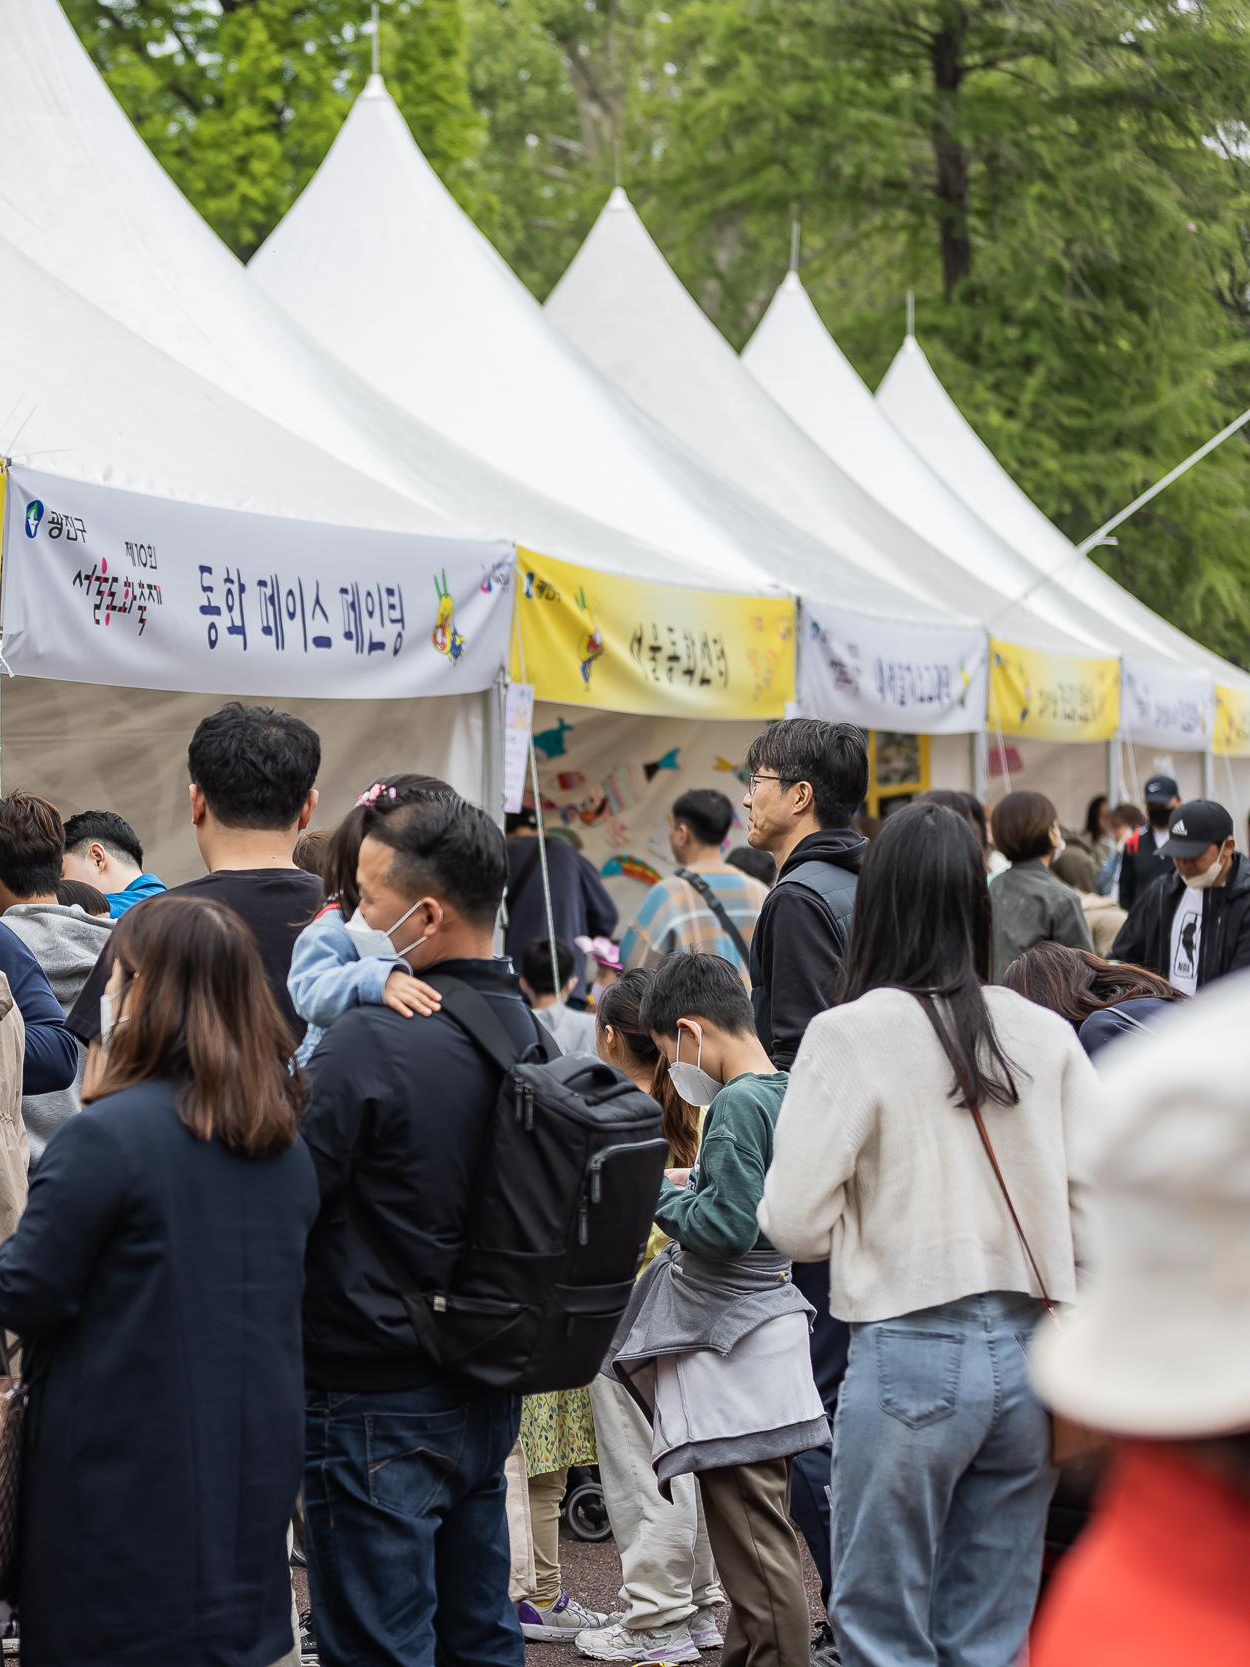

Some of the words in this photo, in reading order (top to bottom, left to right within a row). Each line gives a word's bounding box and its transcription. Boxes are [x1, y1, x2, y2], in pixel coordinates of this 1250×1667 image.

[47, 510, 88, 544] 광진구
[124, 541, 158, 570] 제10회
[72, 556, 163, 637] 서울동화축제
[198, 564, 248, 652] 동화
[256, 573, 333, 654] 페이스
[338, 581, 406, 658] 페인팅
